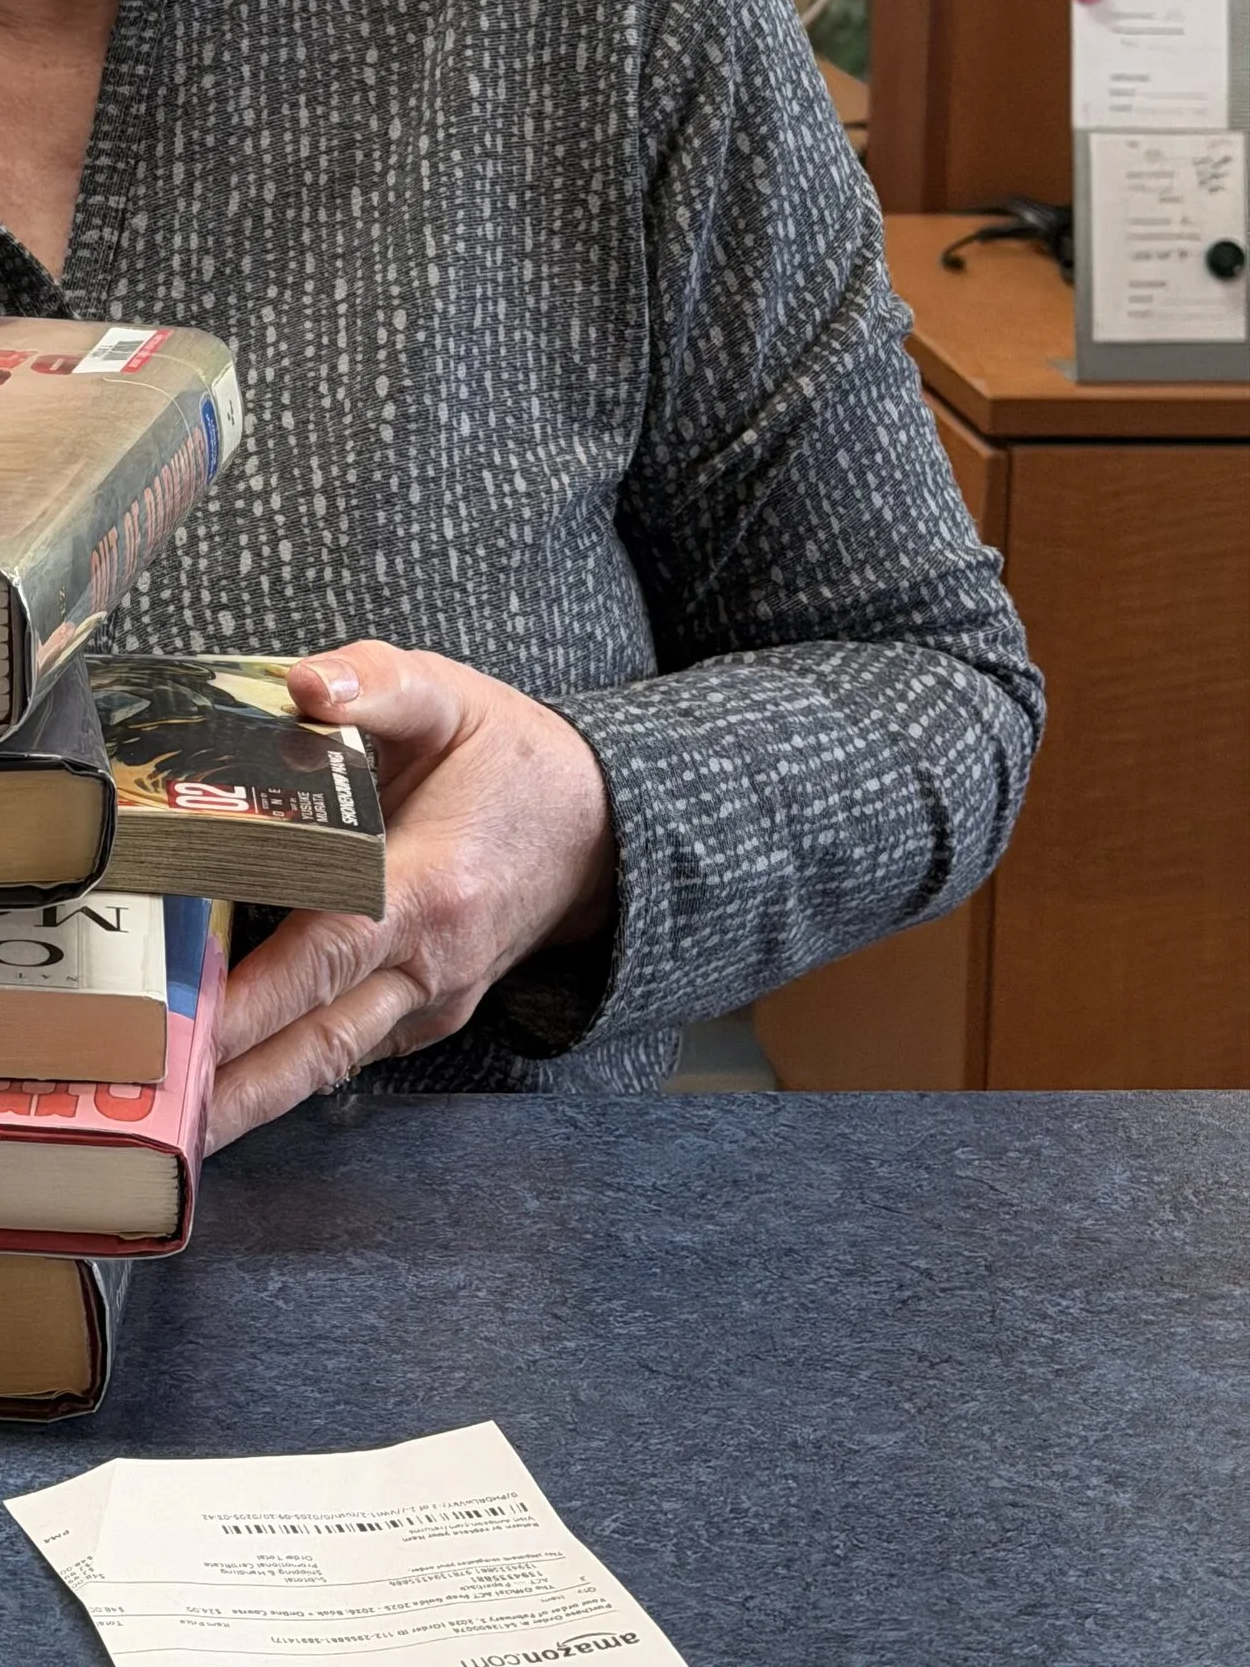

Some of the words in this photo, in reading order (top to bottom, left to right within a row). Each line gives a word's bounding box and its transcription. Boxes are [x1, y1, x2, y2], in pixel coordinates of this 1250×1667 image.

[174, 782, 250, 812] 02
[297, 791, 315, 820] YUSUKE
[312, 793, 329, 823] MURATA
[220, 1568, 266, 1576] Handling
[444, 1592, 470, 1602] Prep
[472, 1590, 493, 1599] ACT
[496, 1587, 533, 1597] Official
[386, 1601, 411, 1612] 2025
[413, 1597, 444, 1607] Guide
[566, 1603, 612, 1618] Purchase
[492, 1613, 536, 1623] February
[533, 1613, 563, 1625] Order
[460, 1632, 640, 1667] amazon.com
